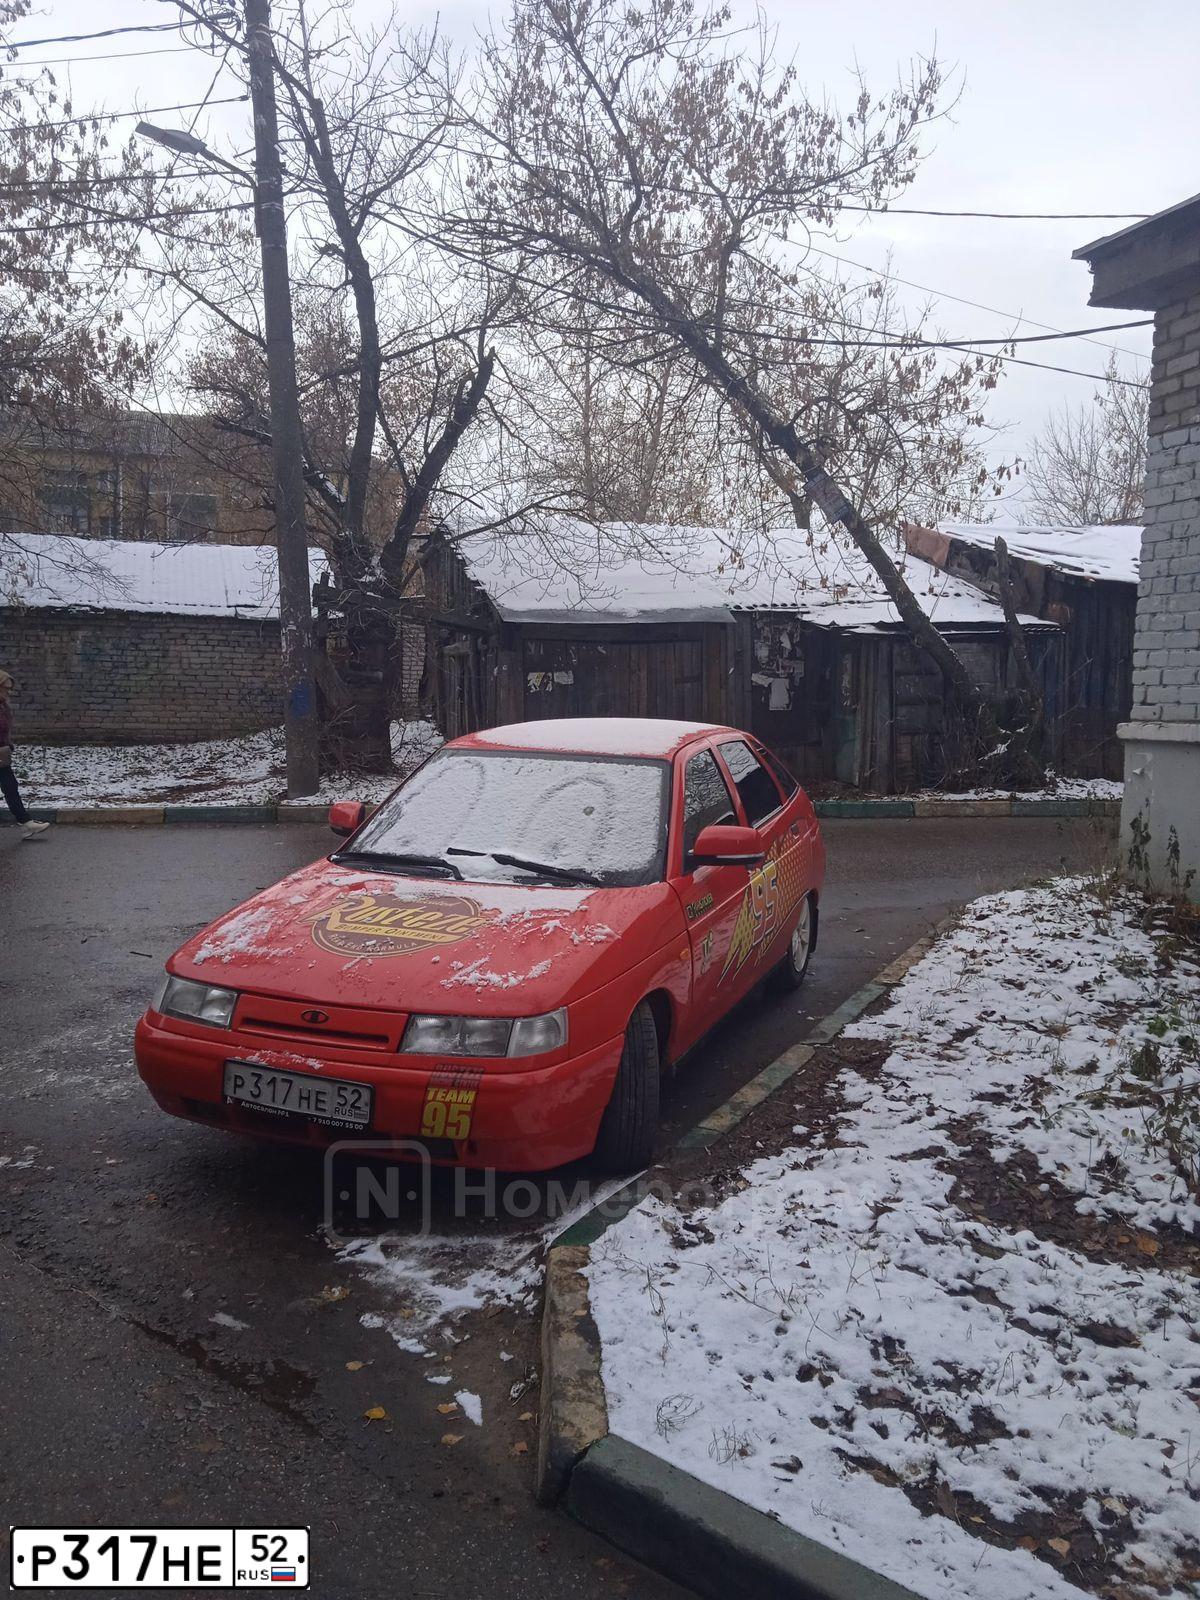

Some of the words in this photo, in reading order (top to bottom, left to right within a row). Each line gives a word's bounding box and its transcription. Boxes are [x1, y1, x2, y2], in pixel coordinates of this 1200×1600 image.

[336, 1085, 362, 1110] 52
[427, 1087, 477, 1104] TEAM
[334, 1106, 354, 1118] RUS
[421, 1101, 472, 1140] 95
